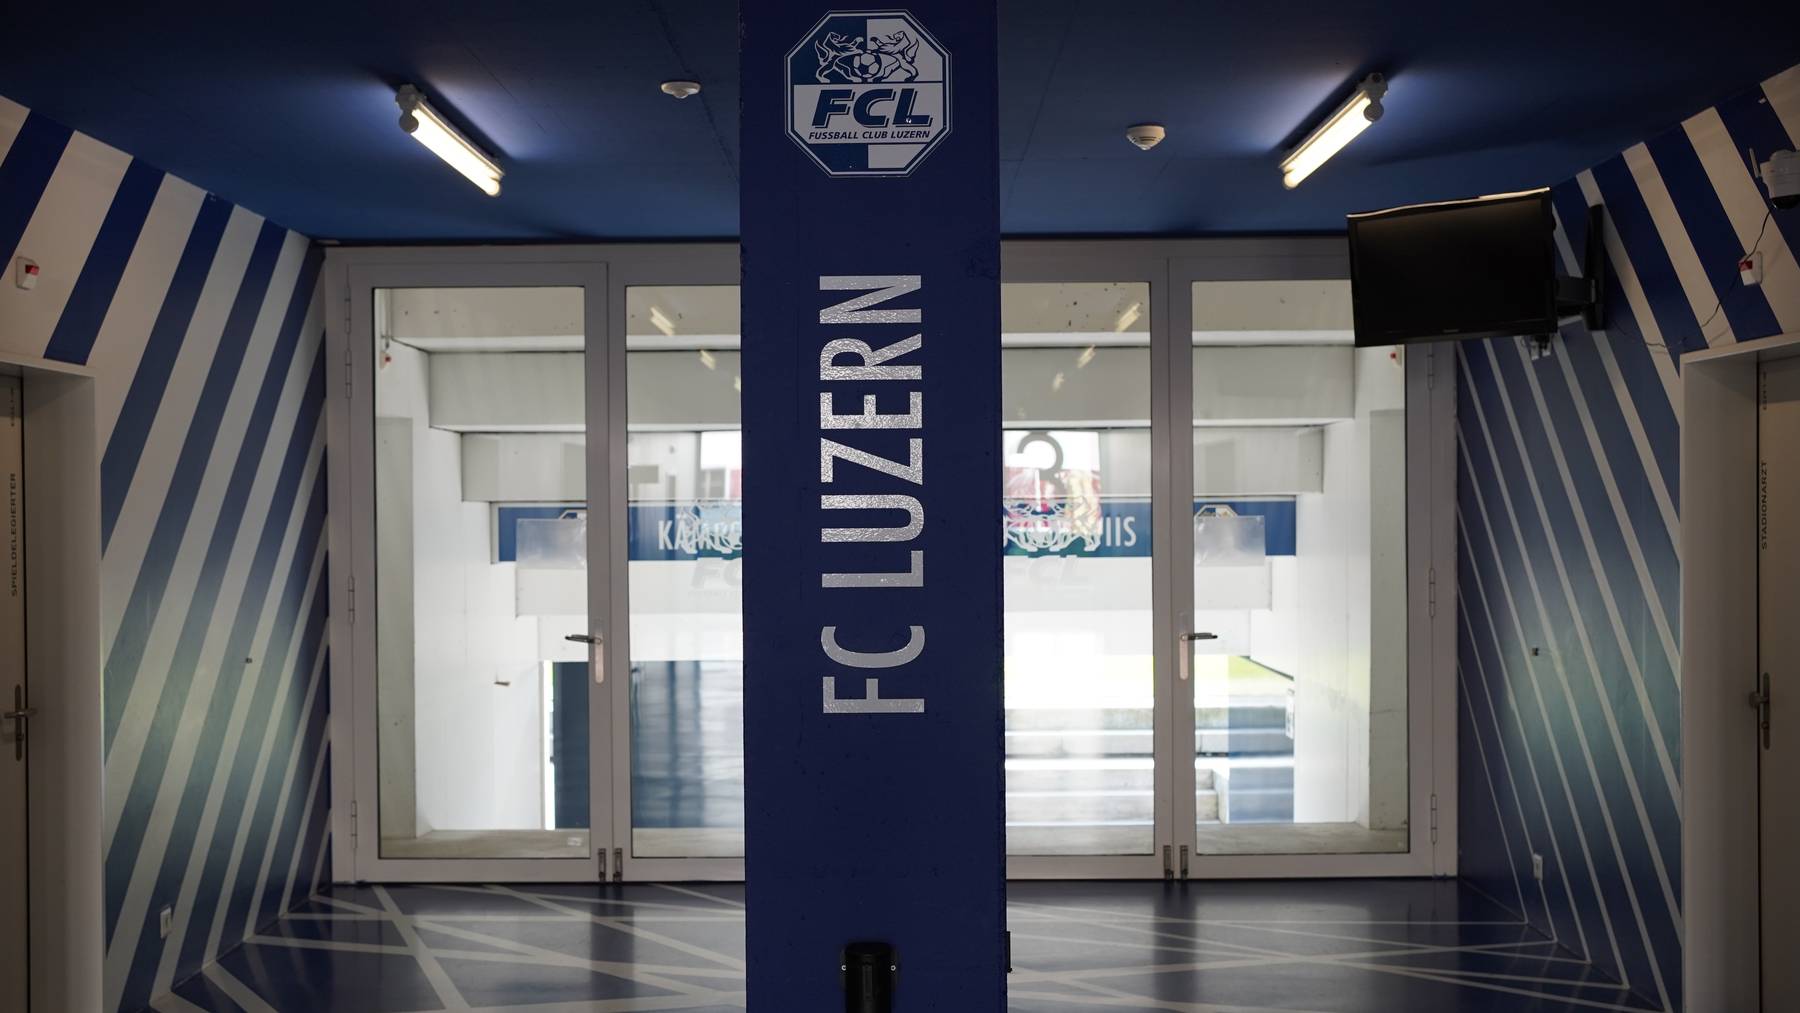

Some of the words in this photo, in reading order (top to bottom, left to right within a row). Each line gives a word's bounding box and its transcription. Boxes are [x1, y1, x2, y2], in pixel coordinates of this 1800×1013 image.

[808, 131, 859, 140] FUSSBALL
[862, 130, 888, 139] CLUB
[890, 130, 931, 139] LUZERN
[812, 88, 933, 128] FCL
[819, 275, 925, 588] LUZERN
[10, 472, 18, 597] SPIELDELEGIERTER
[820, 625, 926, 714] FC
